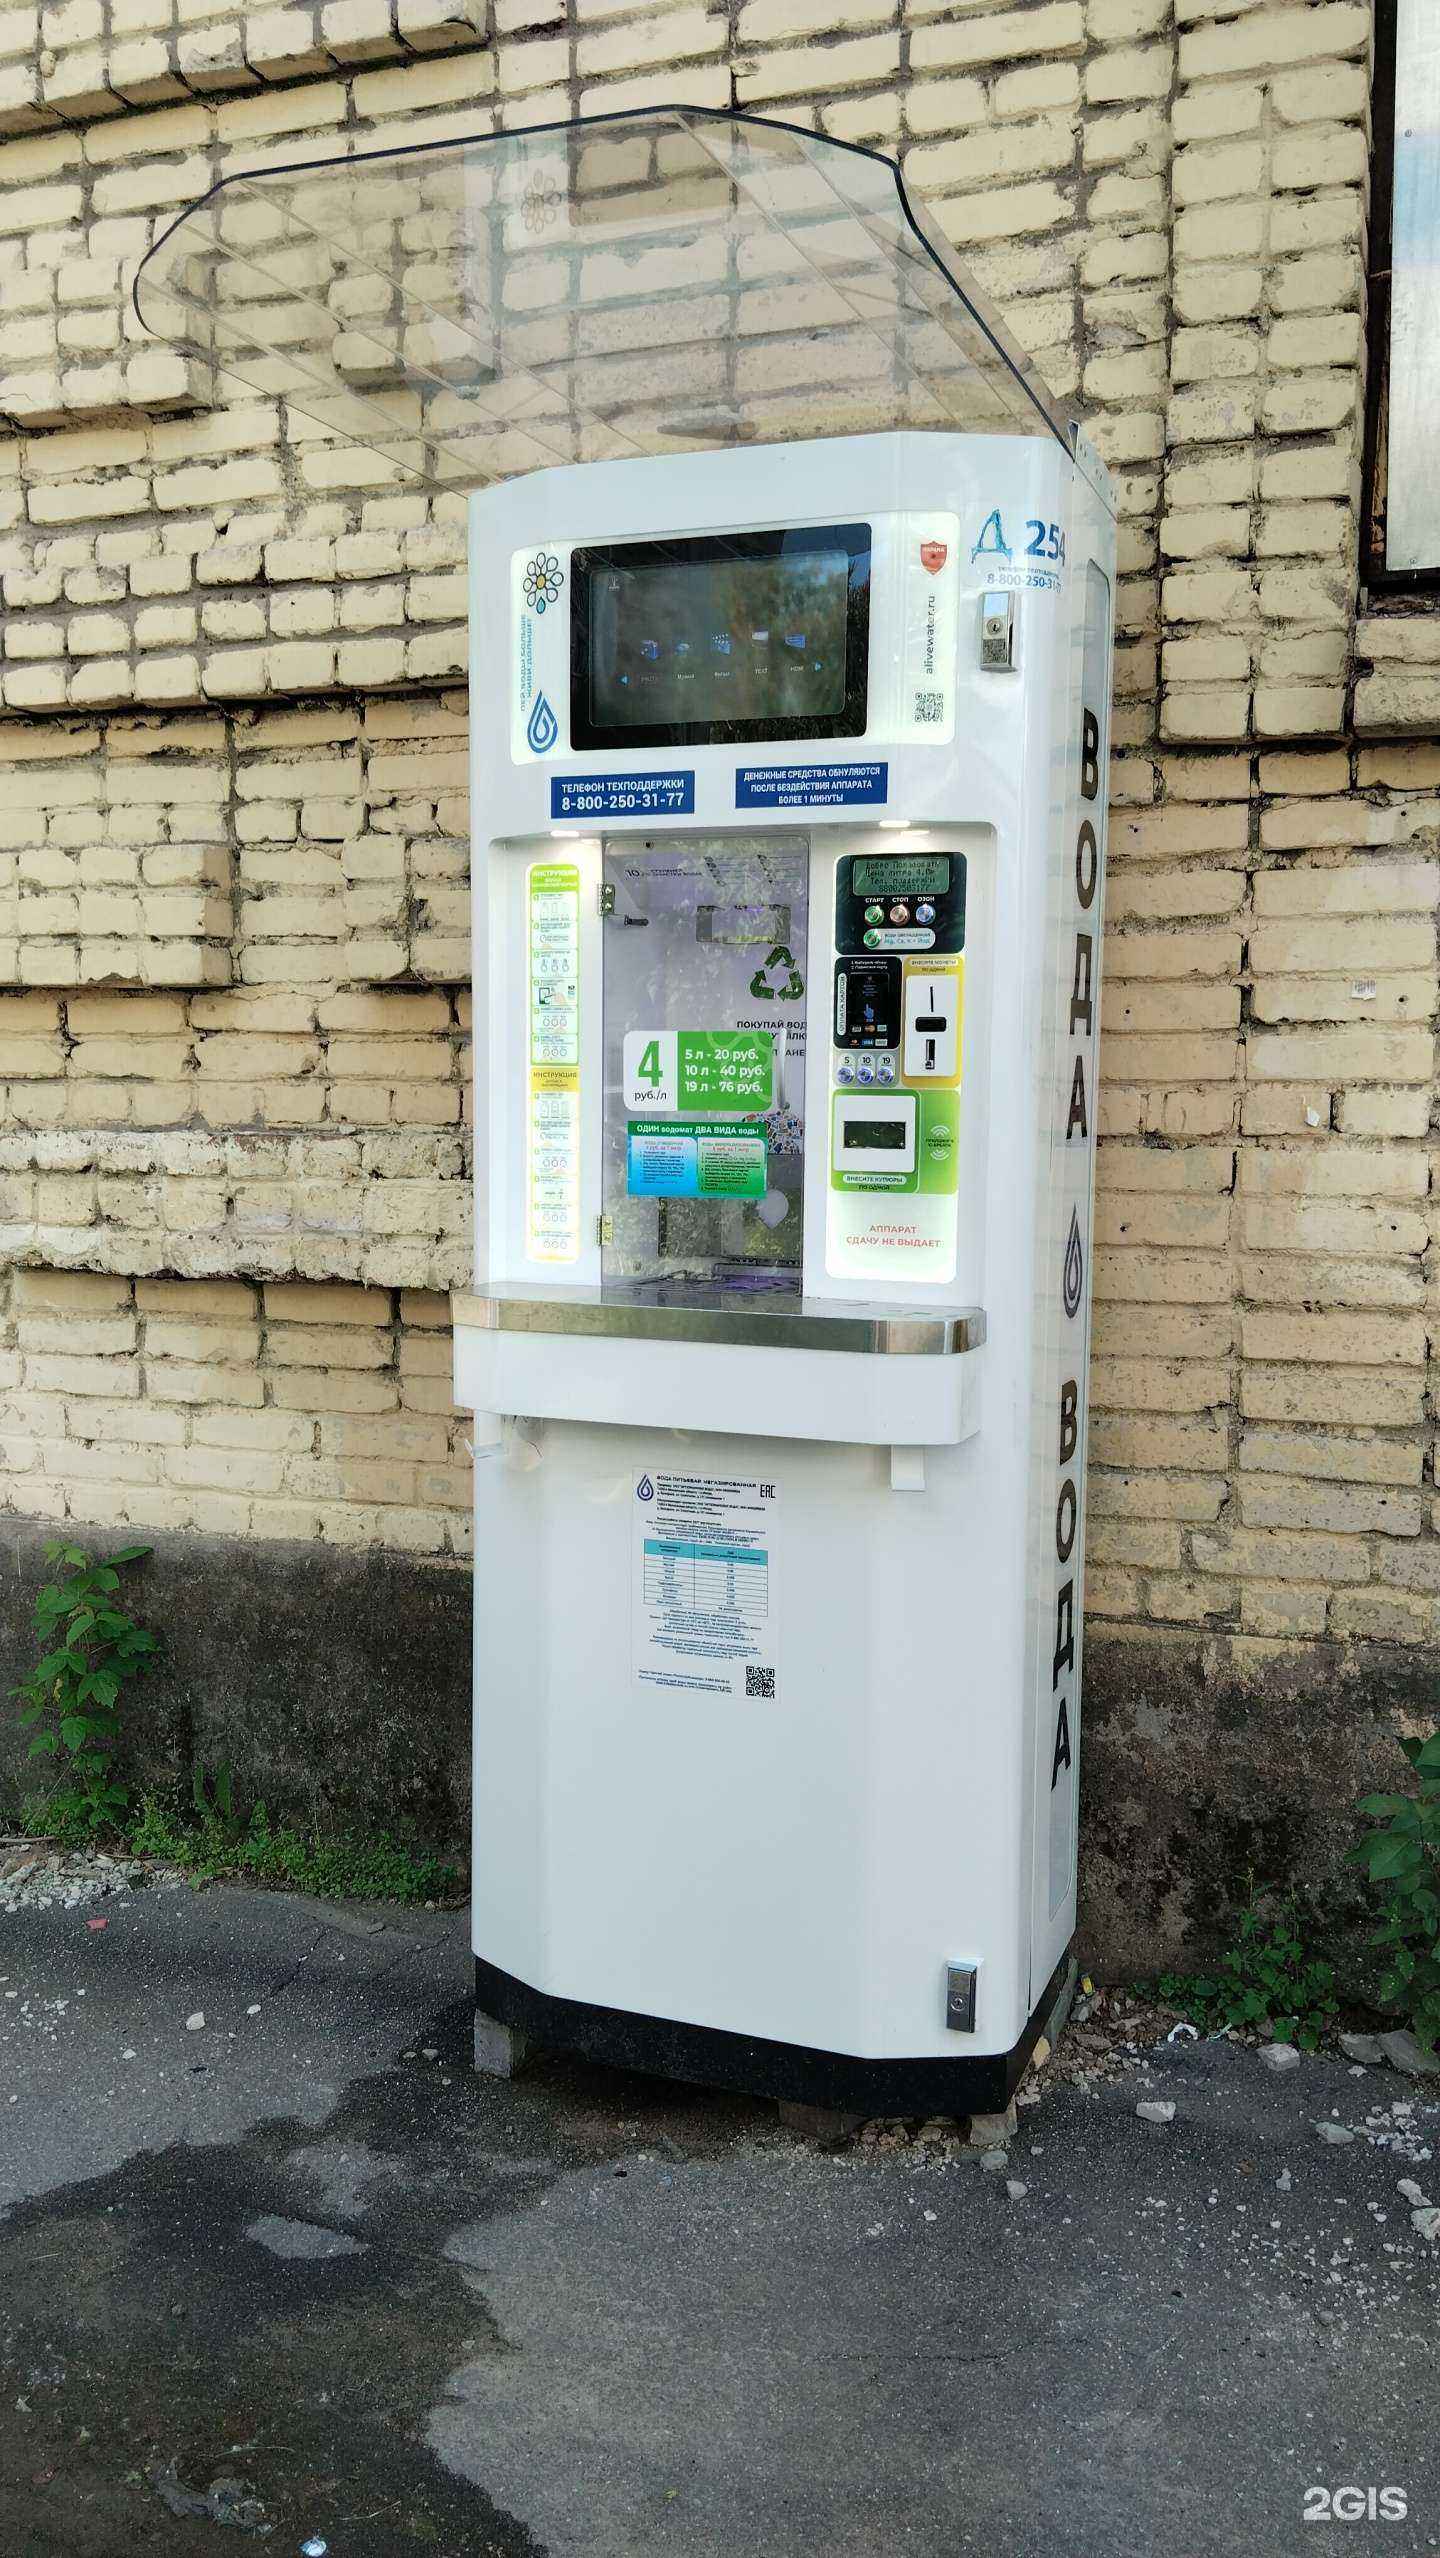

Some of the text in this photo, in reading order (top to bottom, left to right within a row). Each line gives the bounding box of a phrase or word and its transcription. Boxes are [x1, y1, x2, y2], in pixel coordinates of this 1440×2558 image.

[924, 594, 936, 674] alivewater.ru
[744, 767, 881, 781] ДЕНЕЖНЫЕ СРЕДСТВА ОБНУЛЯЮТСЯ
[562, 779, 685, 794] ТЕЛЕФОН ТЕХПОДДЕРЖКИ
[751, 780, 873, 793] ПОСЛЕ БЕЗДЕЙСТВИЯ АППАРАТА
[561, 792, 685, 811] 8-800-250-31-77
[778, 796, 803, 804] БОЛЕЕ
[810, 794, 844, 803] МИНУТЫ
[1065, 707, 1099, 1140] ВОДА
[736, 1020, 784, 1029] ПОКУПАЙ
[685, 1049, 693, 1060] 5
[695, 1051, 704, 1060] л
[714, 1049, 730, 1060] 20
[732, 1048, 759, 1062] руб.
[844, 1056, 850, 1064] 5
[862, 1056, 871, 1064] 10
[882, 1056, 891, 1064] 19
[638, 1040, 664, 1088] 4
[685, 1065, 698, 1076] 10
[700, 1067, 709, 1076] л
[719, 1065, 737, 1076] 40
[739, 1065, 766, 1078] руб.
[685, 1081, 698, 1092] 19
[700, 1083, 709, 1092] л
[719, 1081, 735, 1092] 76
[737, 1080, 764, 1094] руб.
[634, 1089, 667, 1101] руб./л
[636, 1124, 759, 1136] ОДИН водомат ДВА ВИДА воды
[870, 1225, 918, 1234] АППАРАТ
[846, 1236, 941, 1248] СДАЧУ НЕ ВЫДАЕТ
[760, 1484, 776, 1498] EAC
[1051, 1379, 1078, 1792] ВОДА
